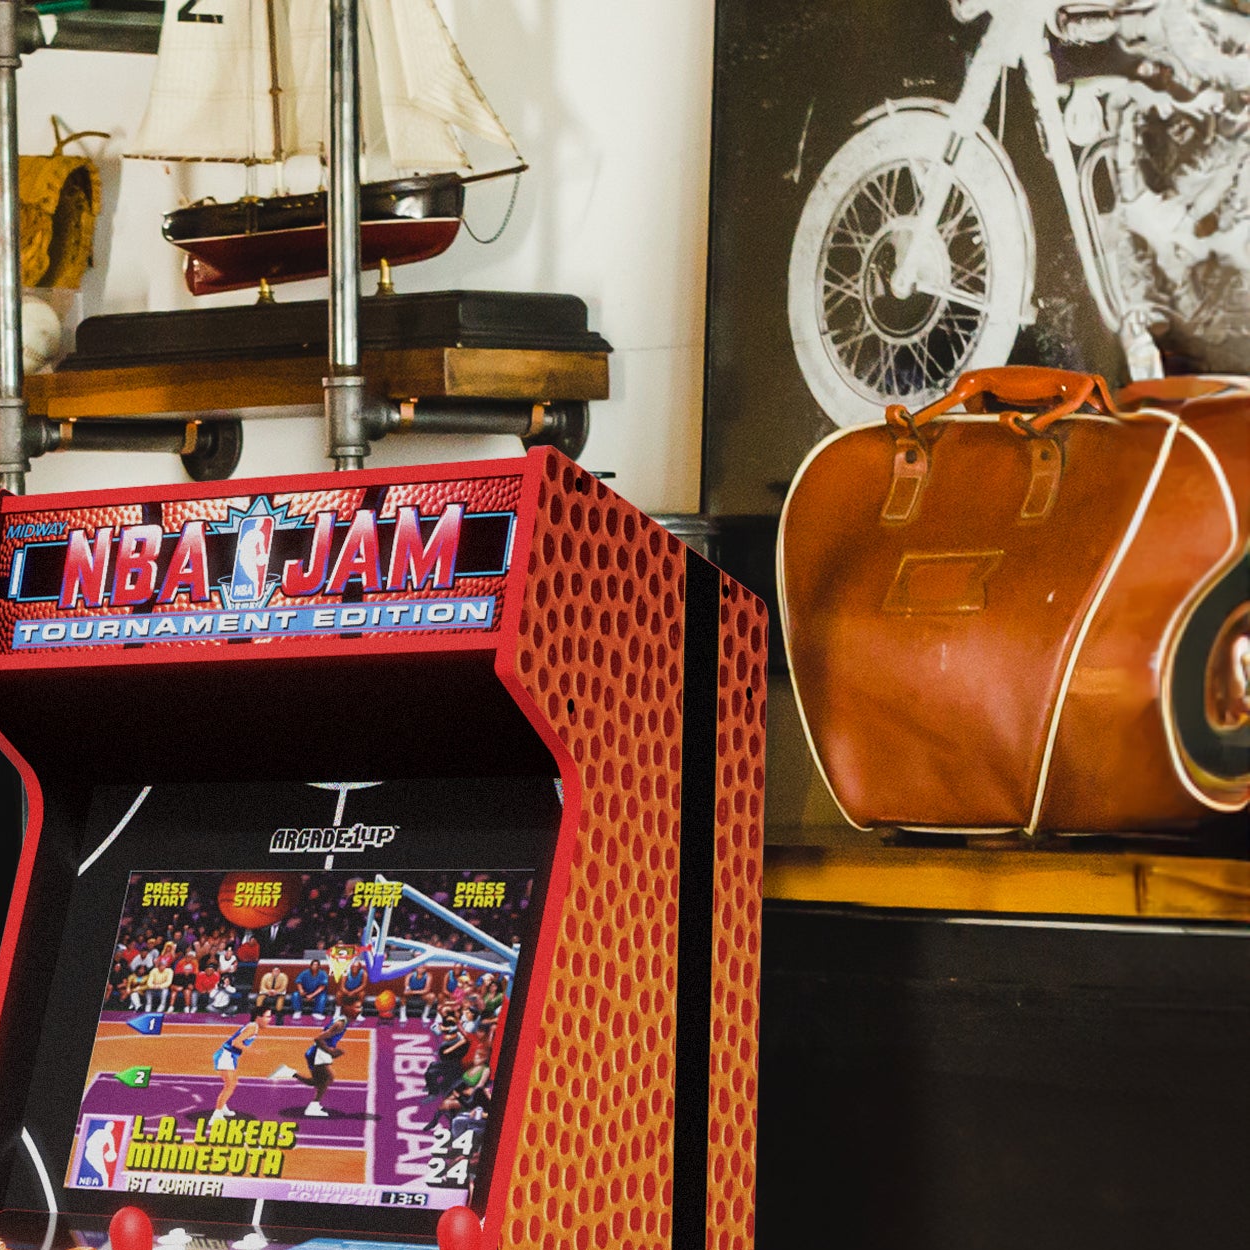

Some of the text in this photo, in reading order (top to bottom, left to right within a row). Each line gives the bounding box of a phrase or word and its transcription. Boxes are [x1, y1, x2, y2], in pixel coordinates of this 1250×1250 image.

[6, 521, 67, 539] MIDWAY
[57, 502, 467, 609] NBA JAM
[18, 602, 489, 642] TOURNAMENT EDITION
[144, 882, 189, 894] PRESS
[235, 882, 282, 894] PRESS
[354, 882, 403, 894] PRESS
[455, 882, 506, 894] PRESS
[141, 894, 188, 908] START
[233, 894, 282, 908] START
[351, 894, 402, 908] START
[453, 894, 505, 908] START
[149, 1017, 156, 1031] 1
[392, 1033, 437, 1100] NBA
[134, 1071, 146, 1084] 2
[132, 1115, 297, 1148] L.A. LAKERS
[432, 1128, 475, 1155] 24
[125, 1141, 285, 1176] MINNESOTA
[426, 1157, 469, 1185] 24
[78, 1176, 100, 1187] NBA
[157, 1177, 224, 1198] QUARTER
